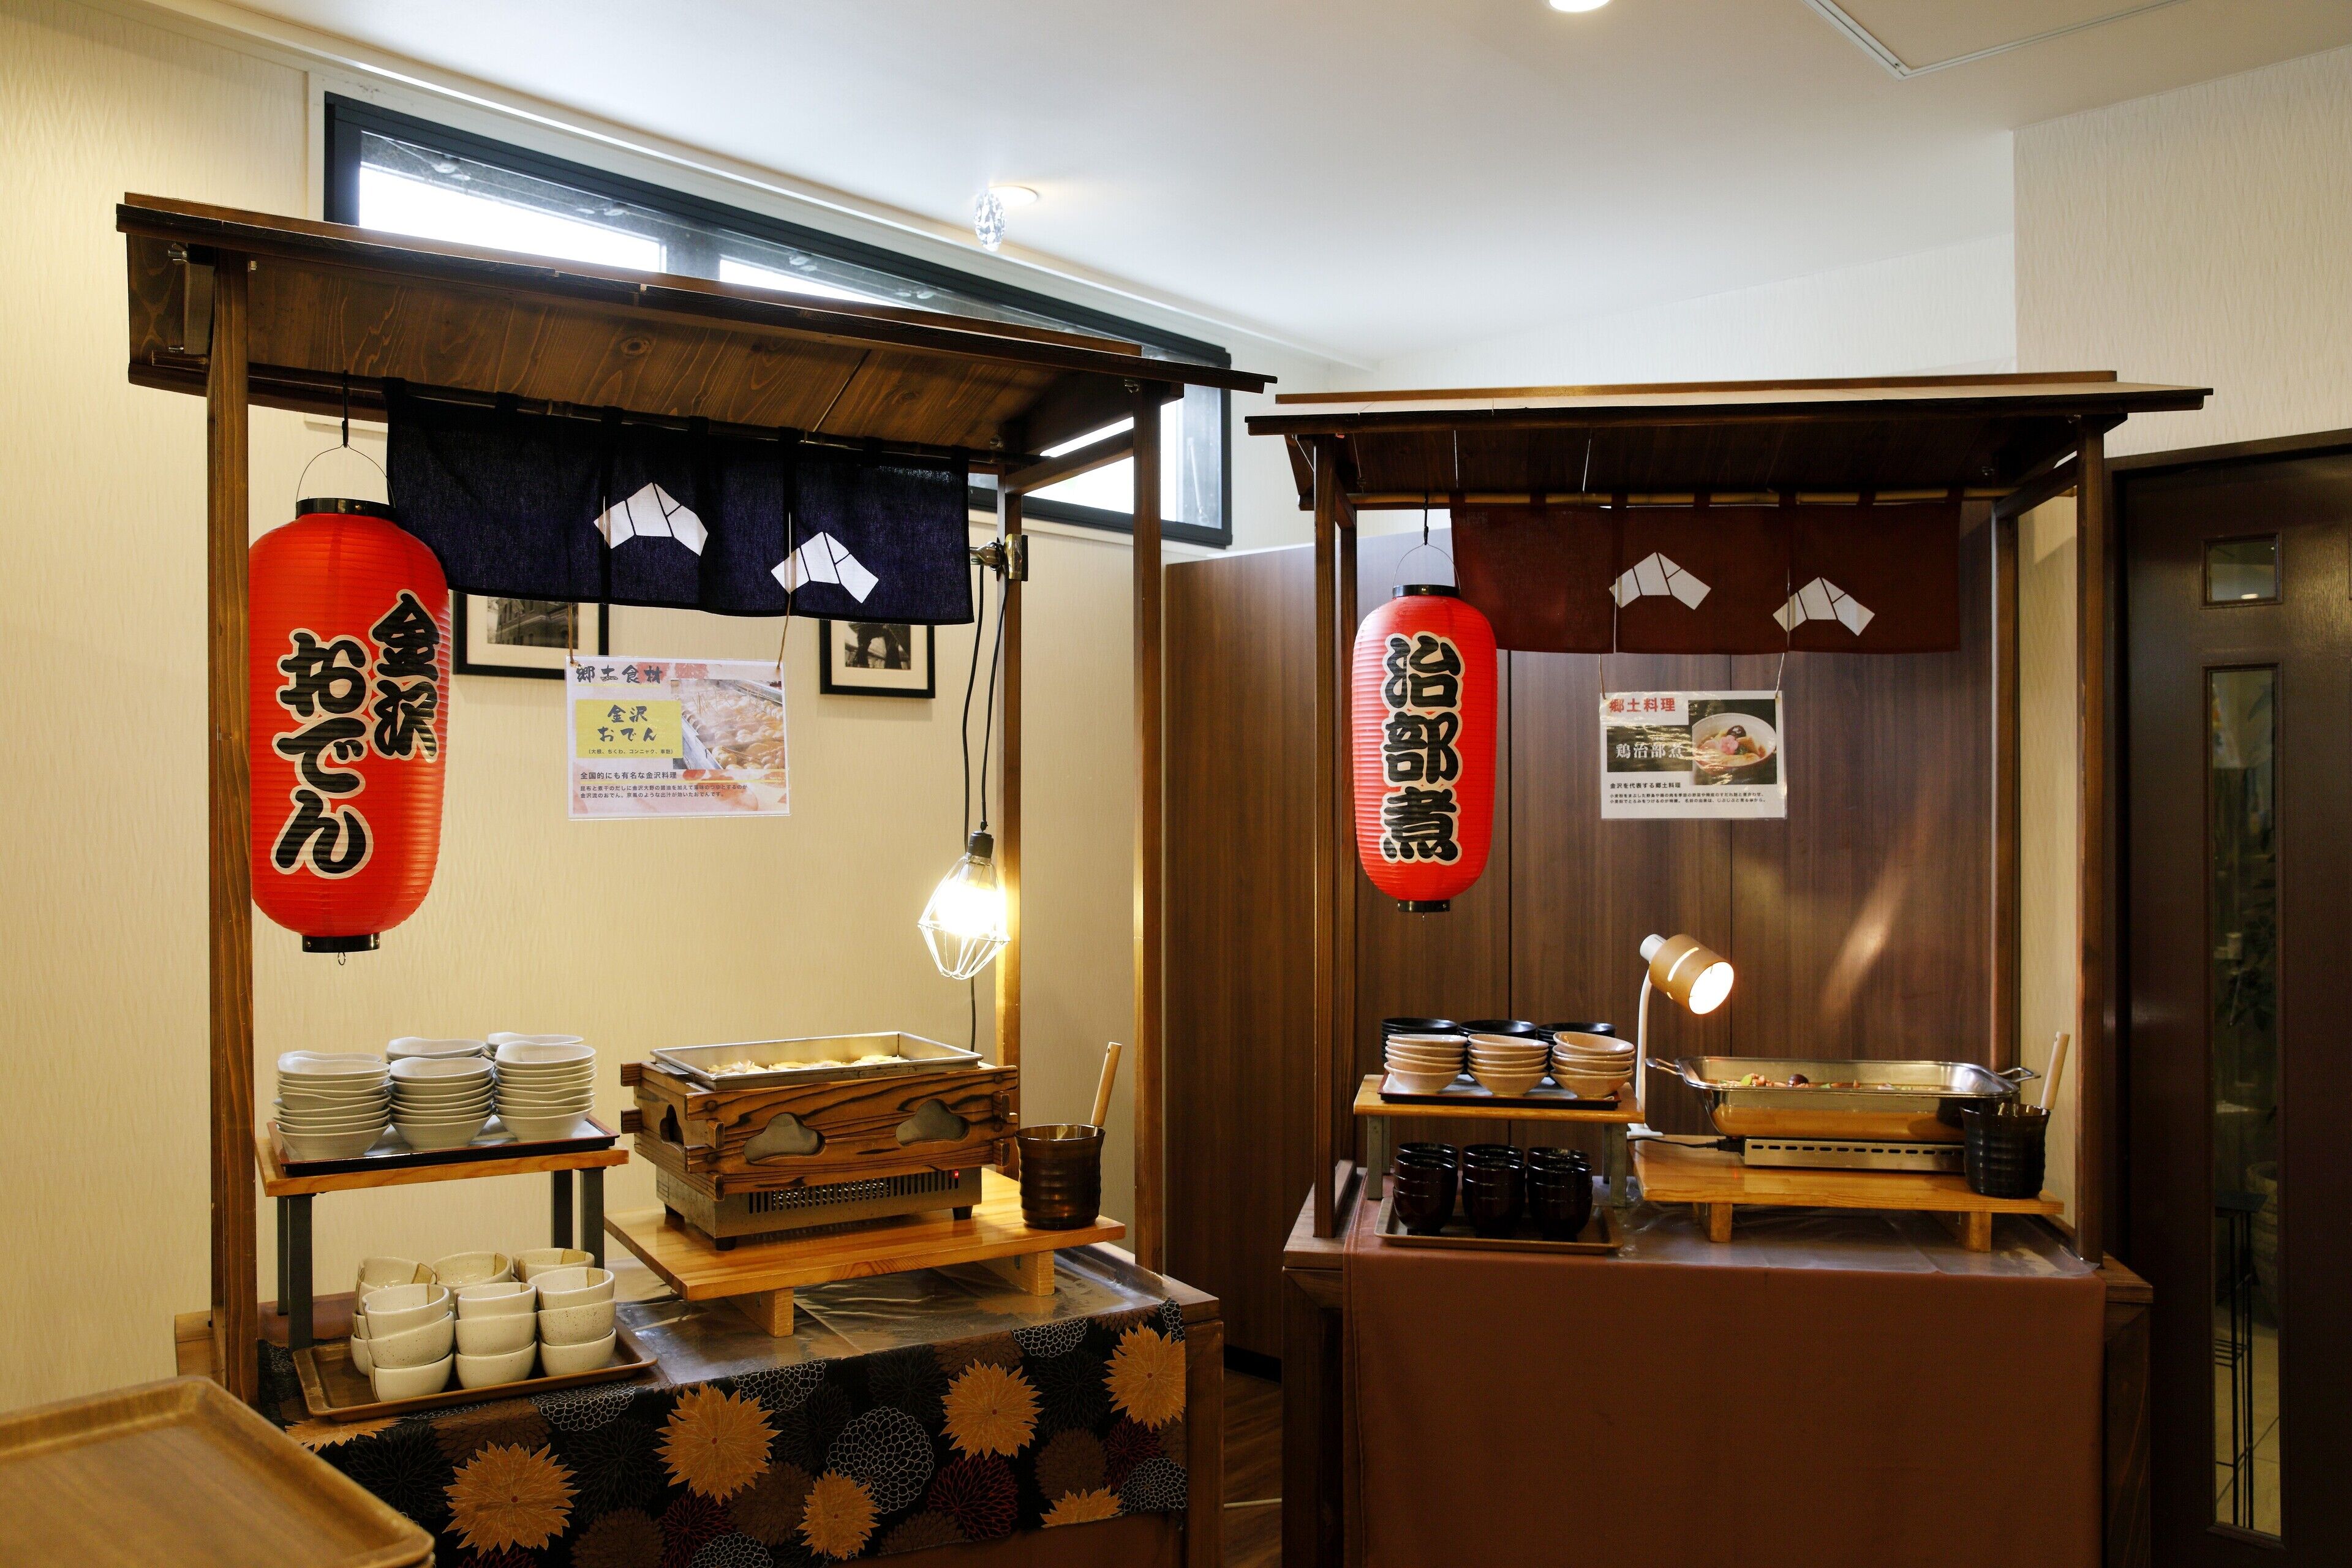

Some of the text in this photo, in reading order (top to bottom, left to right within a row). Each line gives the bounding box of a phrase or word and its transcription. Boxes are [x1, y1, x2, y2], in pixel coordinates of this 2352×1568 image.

[371, 593, 440, 757] 金沢
[576, 664, 663, 684] 郷土食材
[607, 704, 648, 723] 金沢
[1608, 697, 1676, 713] 郷土料理
[597, 726, 657, 742] おでん
[275, 633, 369, 874] おでん
[1383, 635, 1461, 862] 治部煮
[1616, 743, 1684, 759] 鶏治部煮
